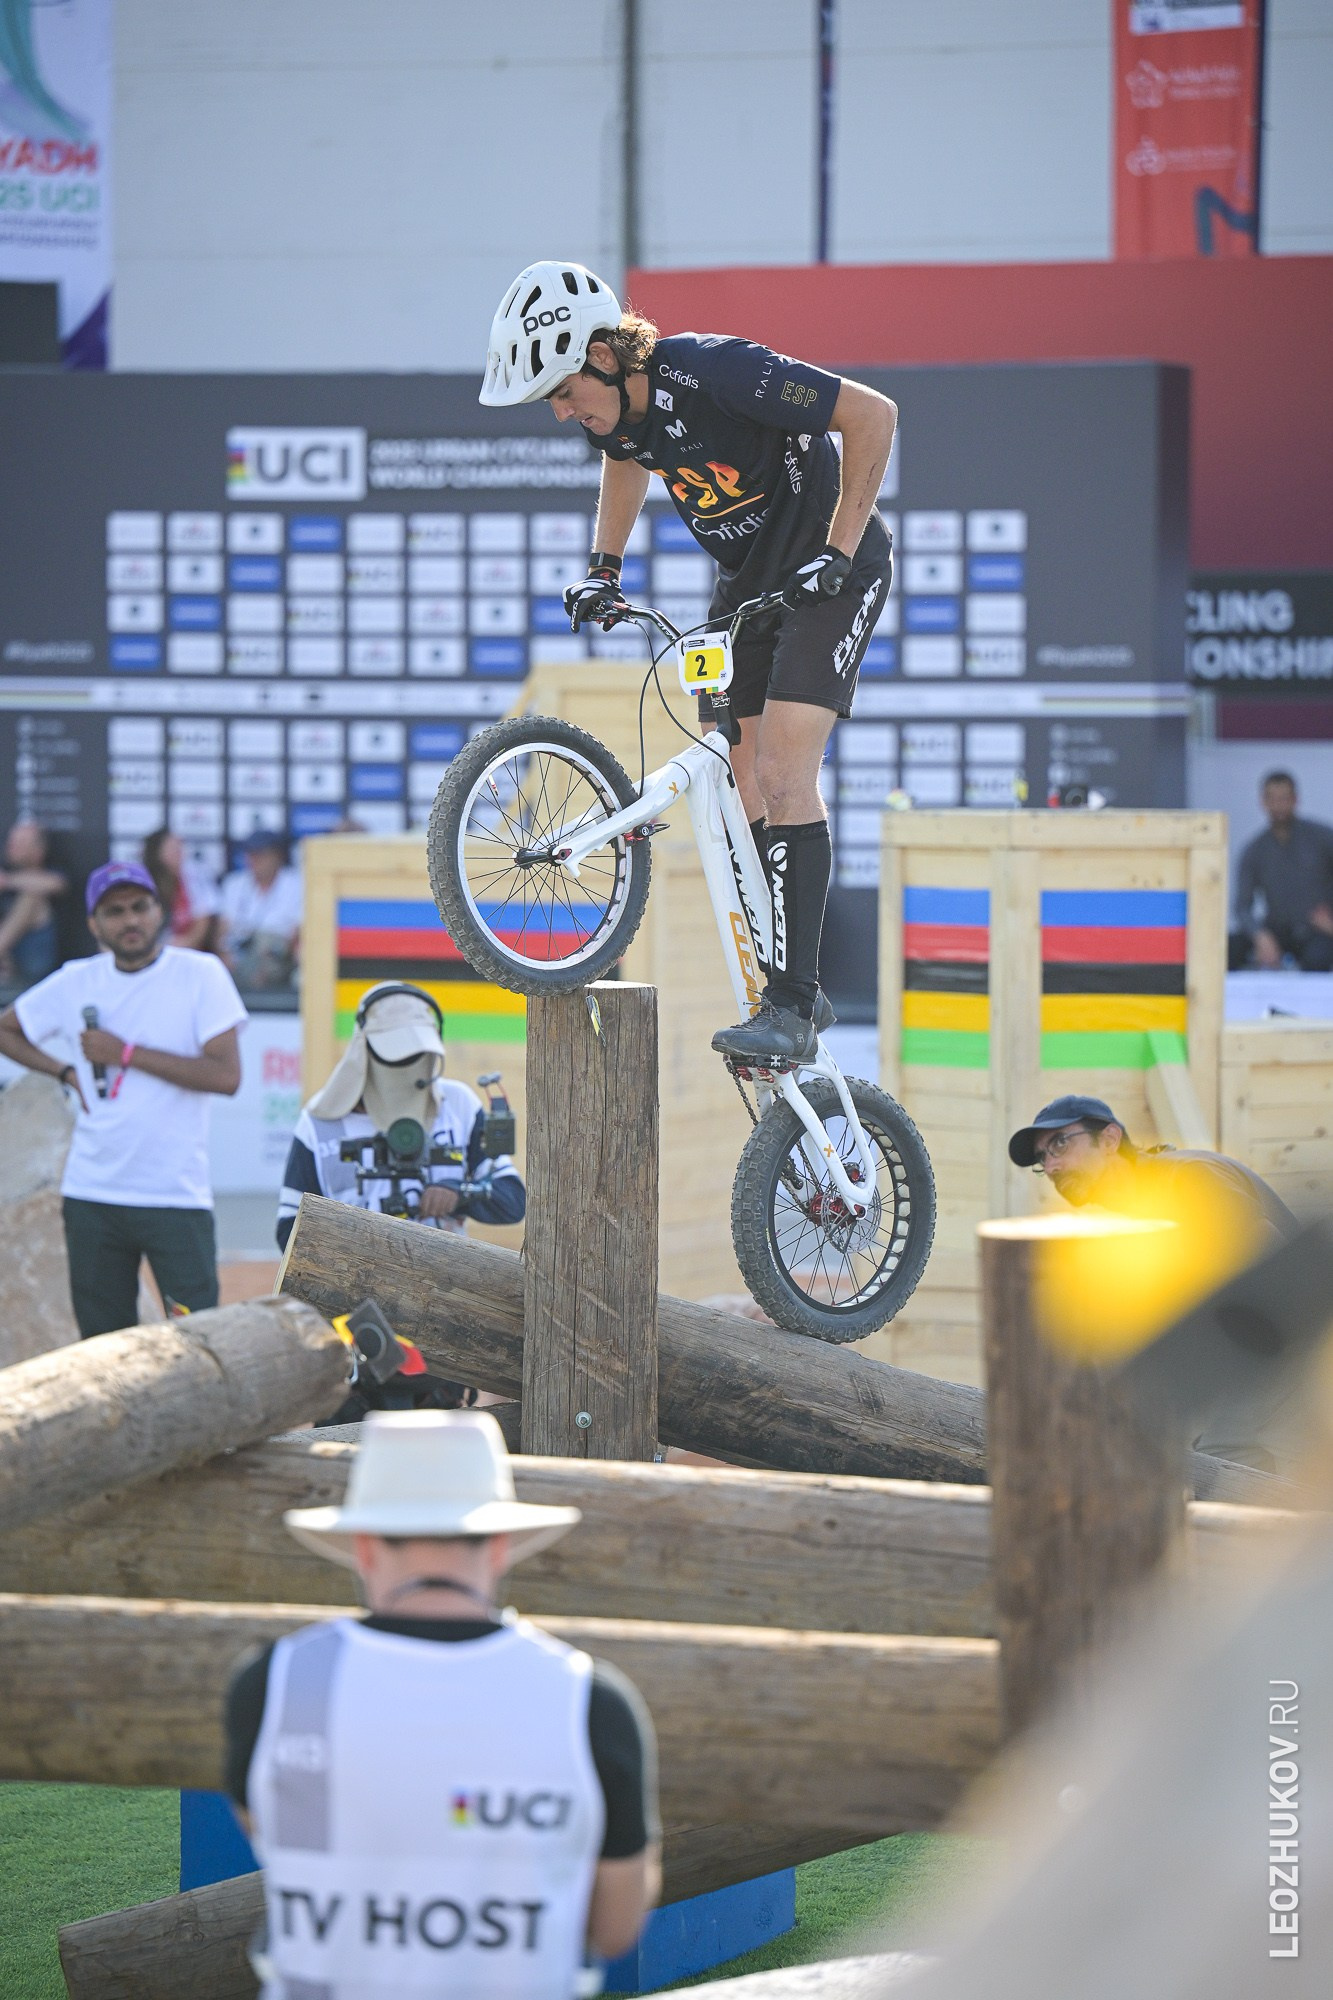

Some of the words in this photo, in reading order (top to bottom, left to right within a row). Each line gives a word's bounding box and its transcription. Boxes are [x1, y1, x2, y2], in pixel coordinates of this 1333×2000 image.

[781, 380, 818, 408] ESP
[256, 444, 348, 484] UCI
[692, 508, 769, 540] Cofidi
[695, 654, 708, 677] 2
[773, 870, 787, 972] CLEAN
[477, 1793, 571, 1829] UCI
[278, 1888, 343, 1942] TV
[364, 1896, 547, 1953] HOST
